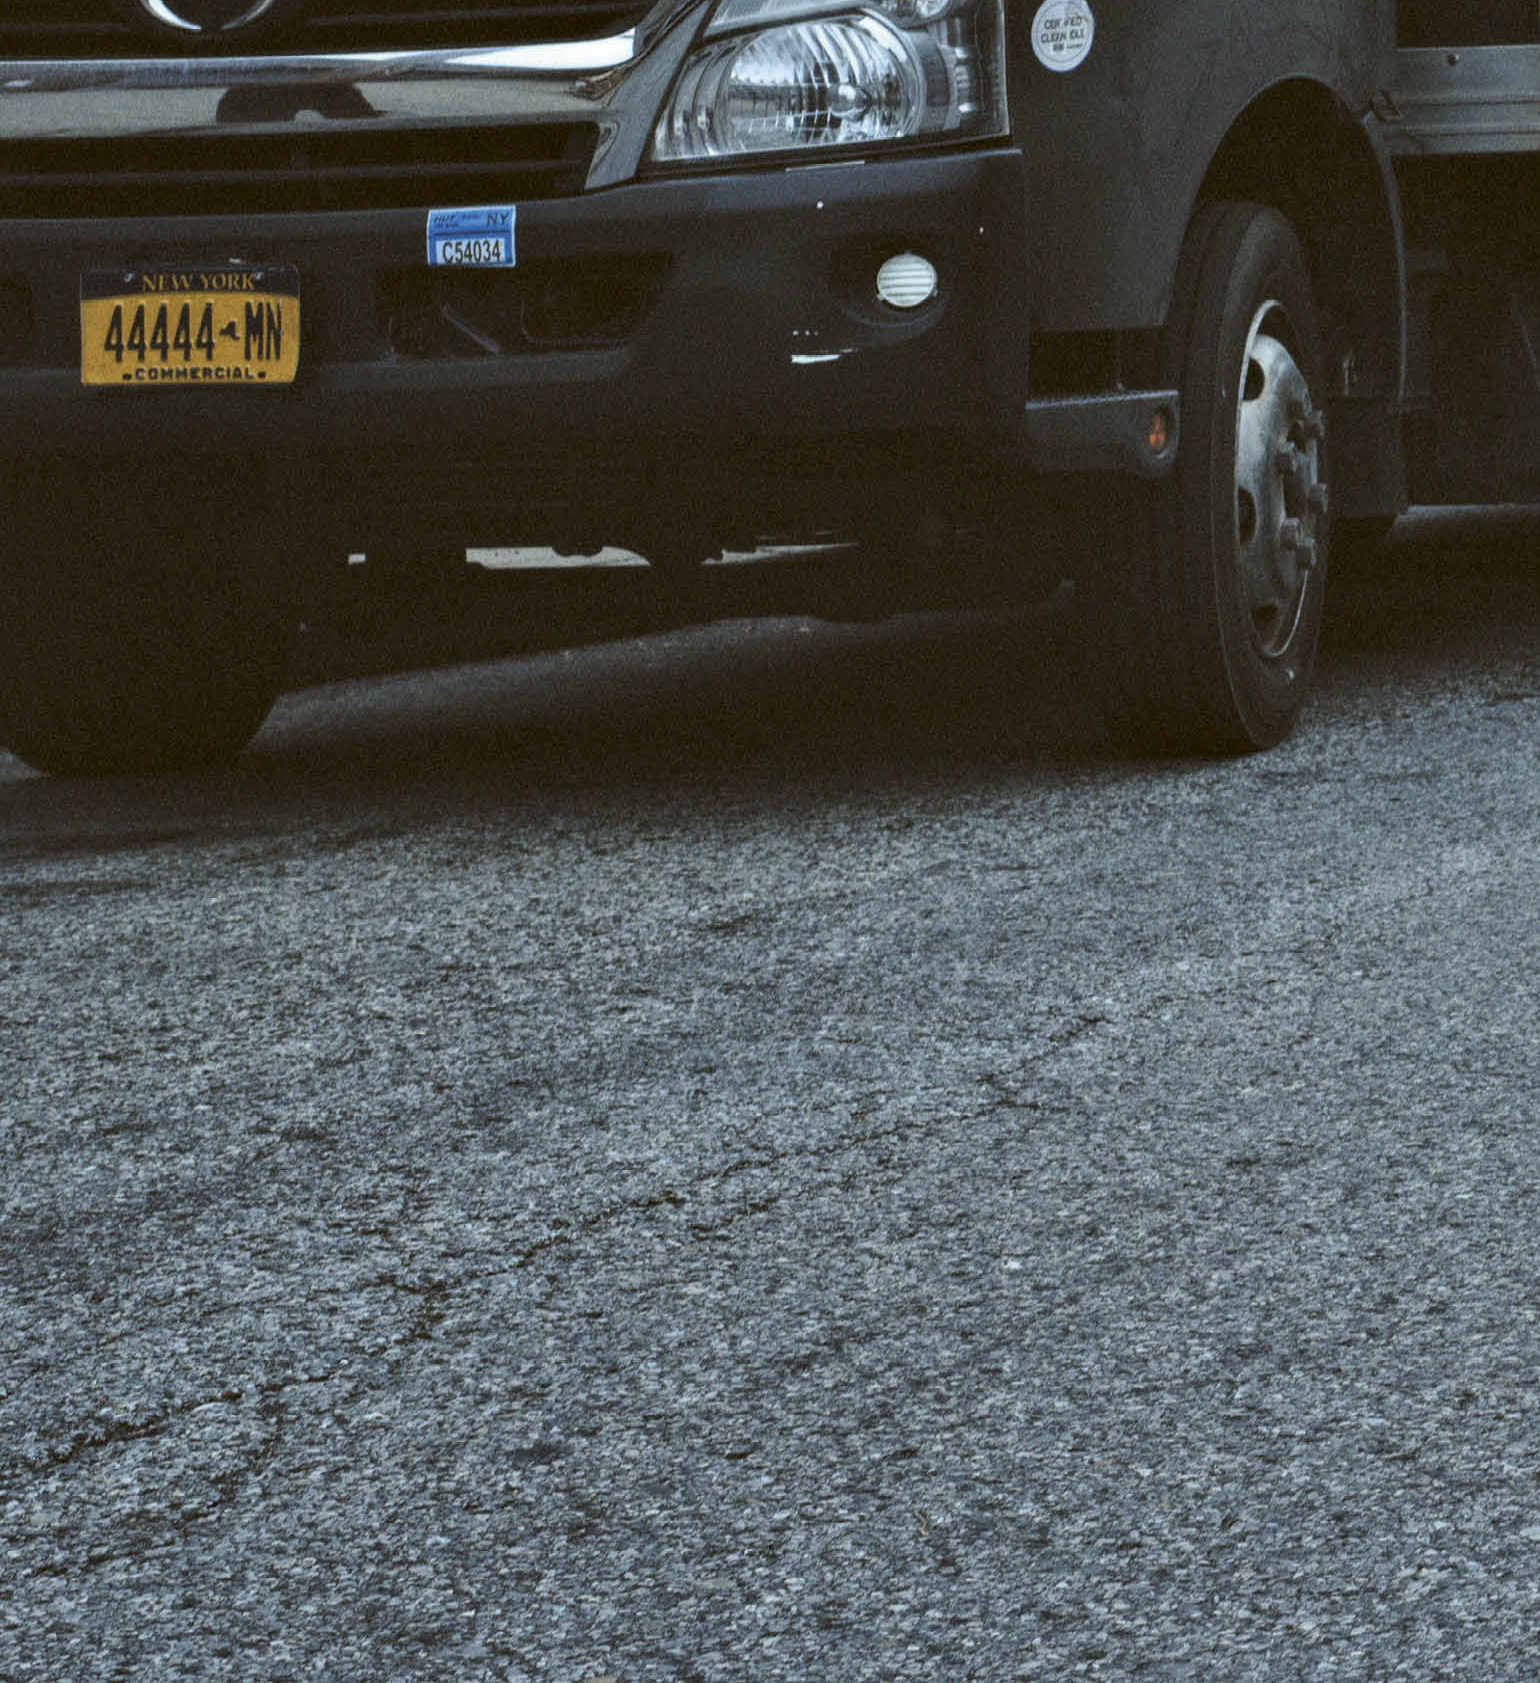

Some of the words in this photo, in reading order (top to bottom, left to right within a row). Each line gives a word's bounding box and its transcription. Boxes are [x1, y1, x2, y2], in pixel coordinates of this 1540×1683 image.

[487, 212, 510, 226] NY
[442, 239, 502, 264] C54034
[141, 273, 193, 291] NEW
[200, 272, 257, 291] YORK
[104, 301, 215, 364] 44444
[244, 300, 283, 362] MN
[134, 366, 255, 382] COMMERCIAL
